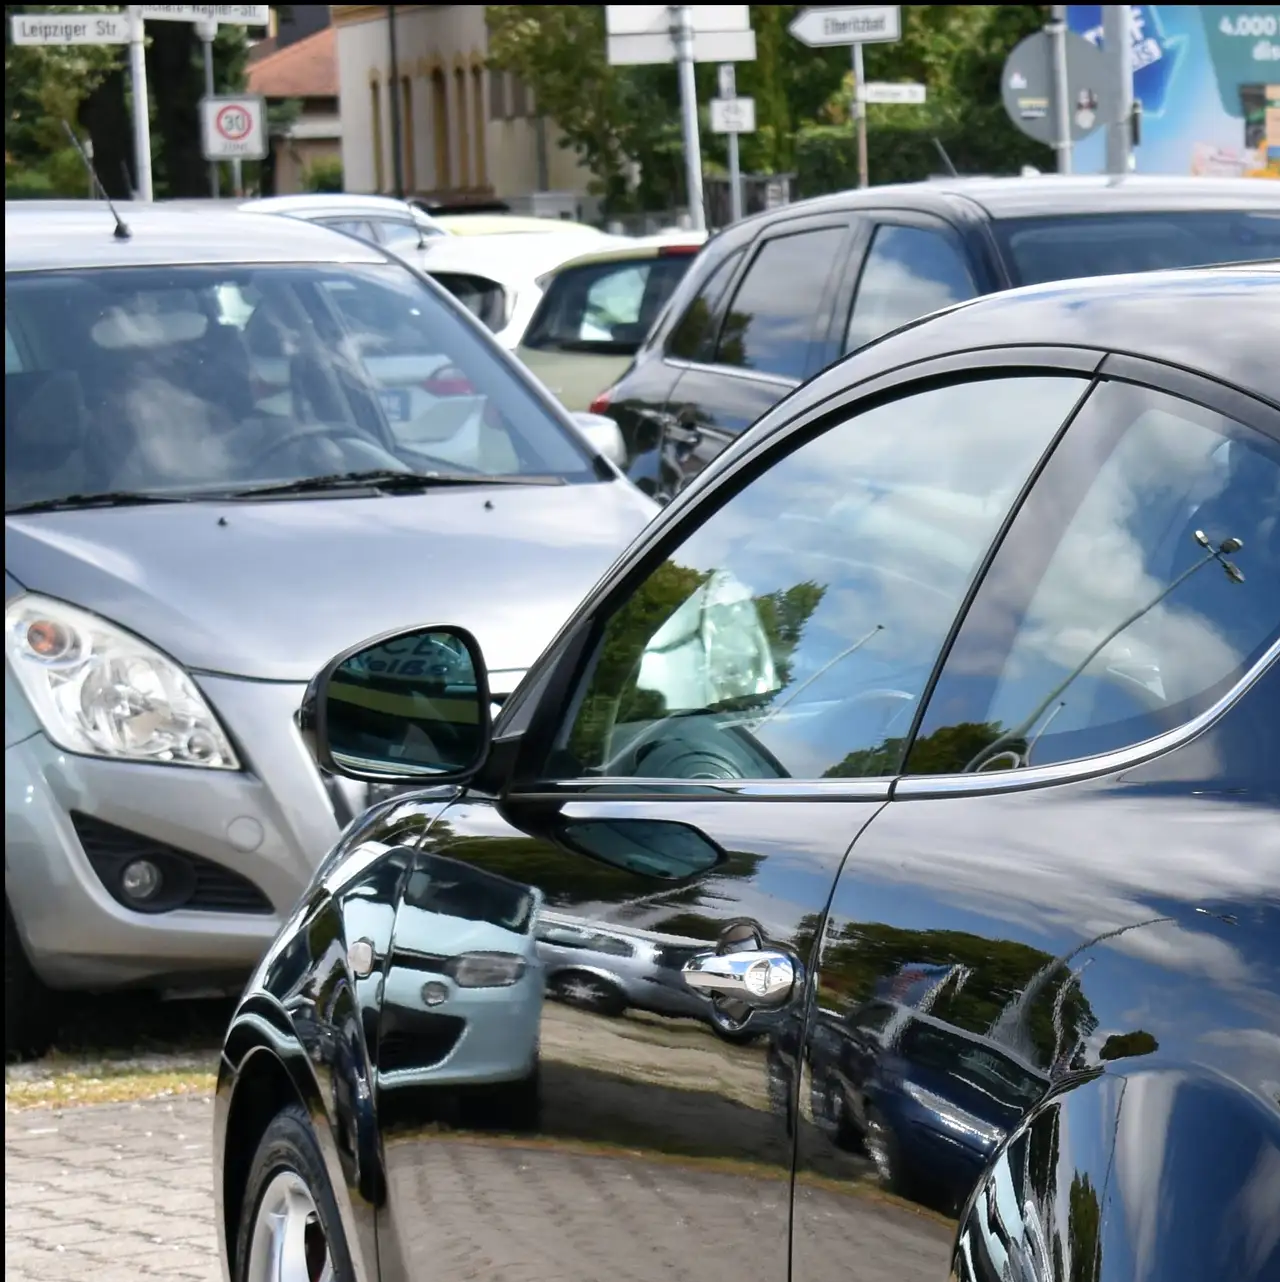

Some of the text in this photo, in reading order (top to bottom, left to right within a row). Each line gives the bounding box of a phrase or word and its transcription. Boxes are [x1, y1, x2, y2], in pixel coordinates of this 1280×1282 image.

[21, 20, 88, 41] Leipziger
[1218, 14, 1277, 36] 4.000
[223, 114, 245, 132] 30
